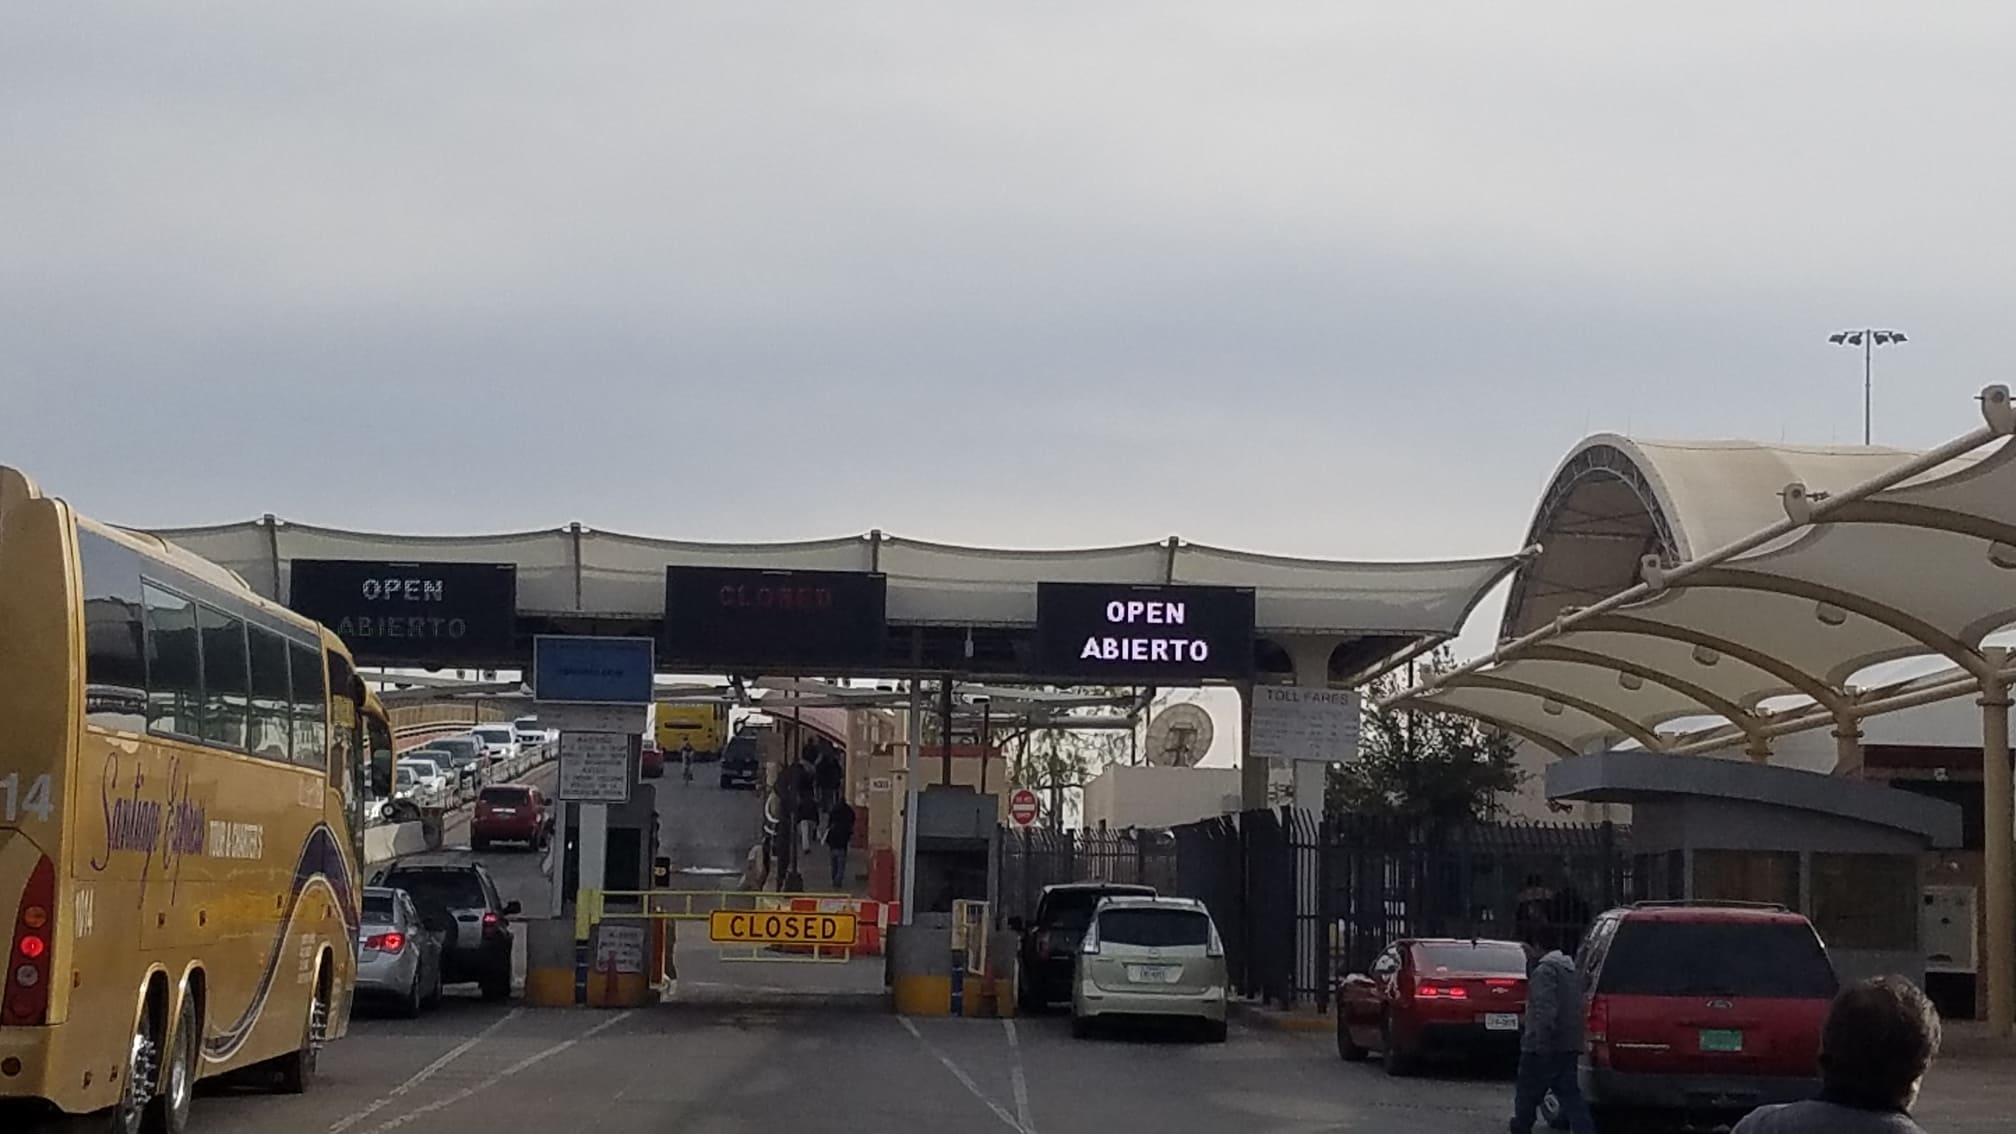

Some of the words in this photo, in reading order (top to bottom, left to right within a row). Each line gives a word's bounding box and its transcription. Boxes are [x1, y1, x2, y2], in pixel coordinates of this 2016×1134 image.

[362, 579, 443, 601] OPEN
[719, 585, 833, 608] CLOSED
[1106, 601, 1185, 624] OPEN
[338, 615, 466, 638] ABIERTO
[1080, 637, 1208, 662] ABIERTO
[1267, 689, 1299, 701] TOLL
[1304, 691, 1348, 705] FARES
[730, 915, 837, 939] CLOSED
